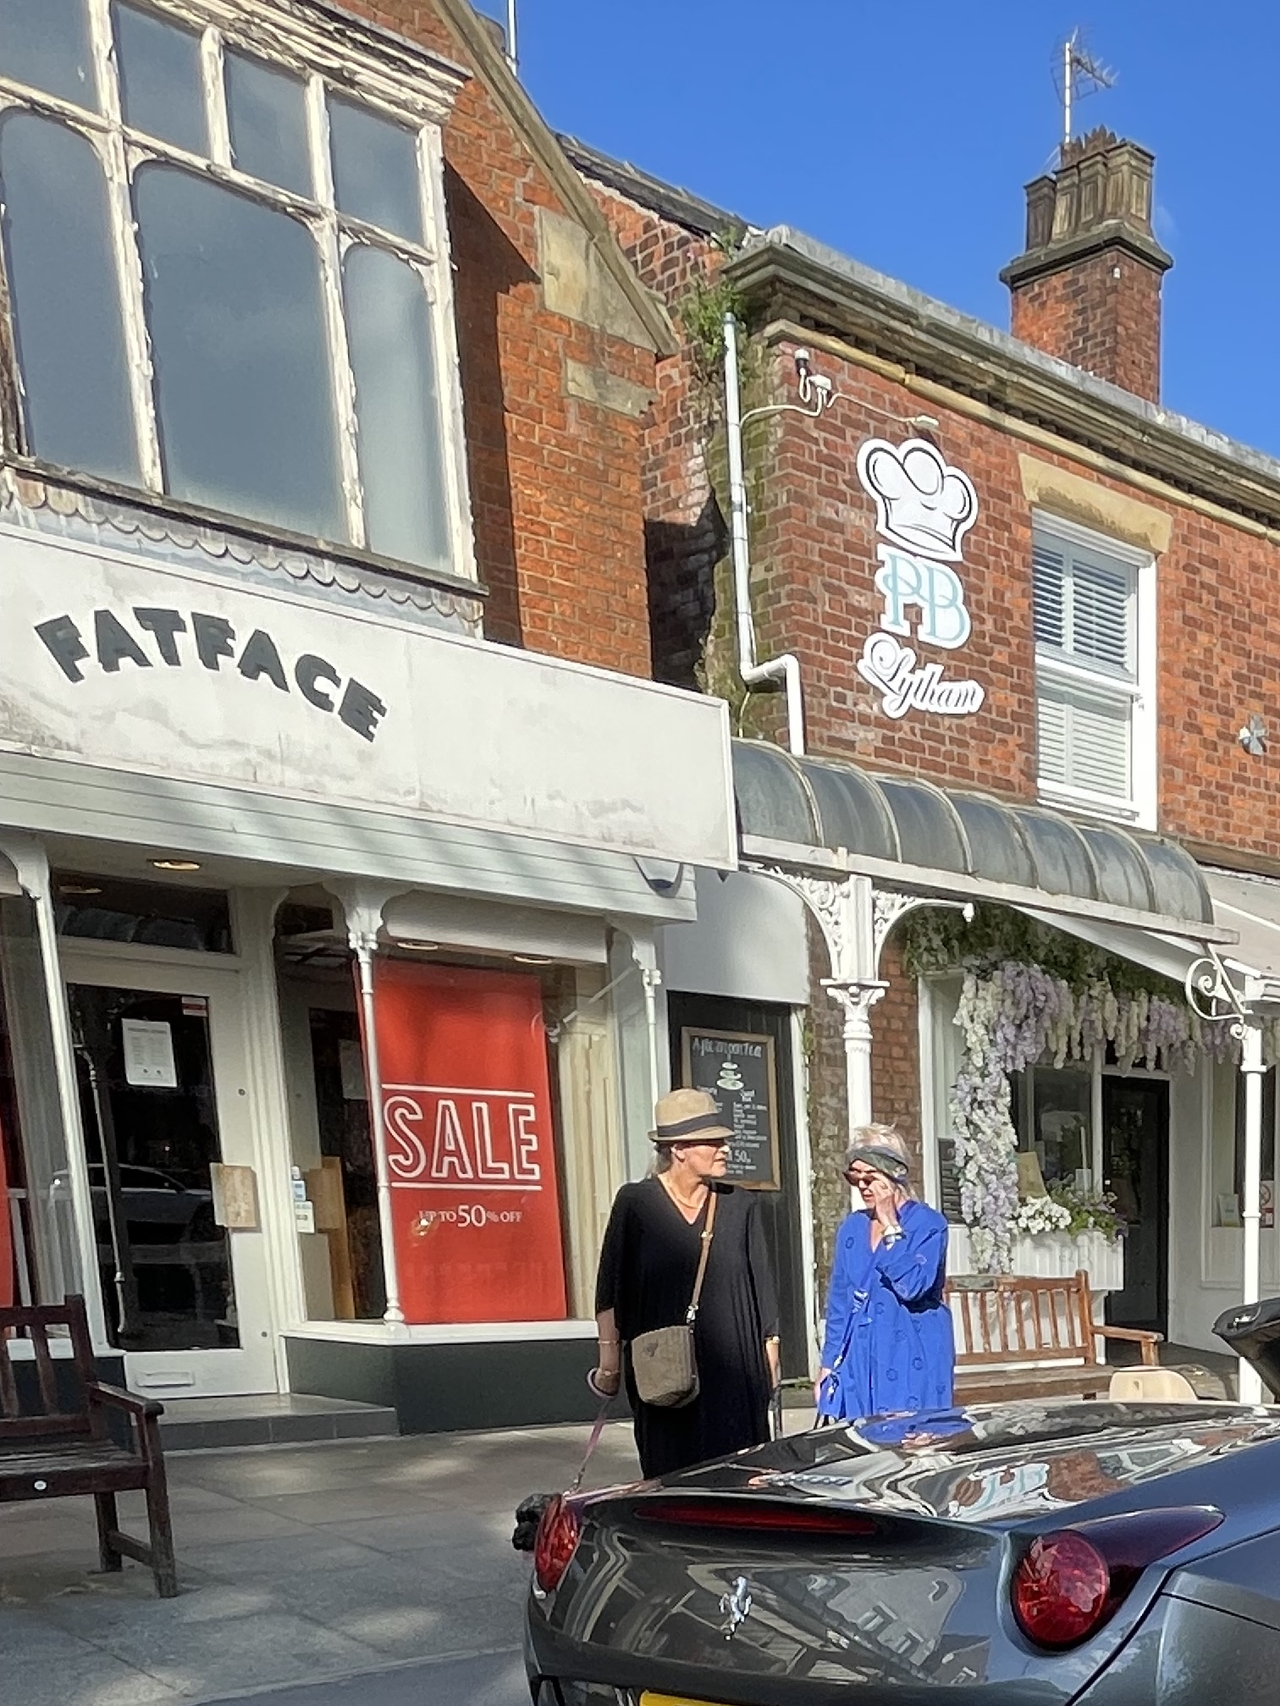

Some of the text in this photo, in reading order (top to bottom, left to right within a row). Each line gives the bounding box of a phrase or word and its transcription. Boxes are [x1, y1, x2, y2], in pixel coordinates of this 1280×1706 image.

[33, 605, 388, 744] FATFACE
[864, 639, 976, 713] Lytham
[384, 1095, 541, 1180] SALE
[440, 1211, 457, 1223] TO
[500, 1211, 523, 1223] OFF
